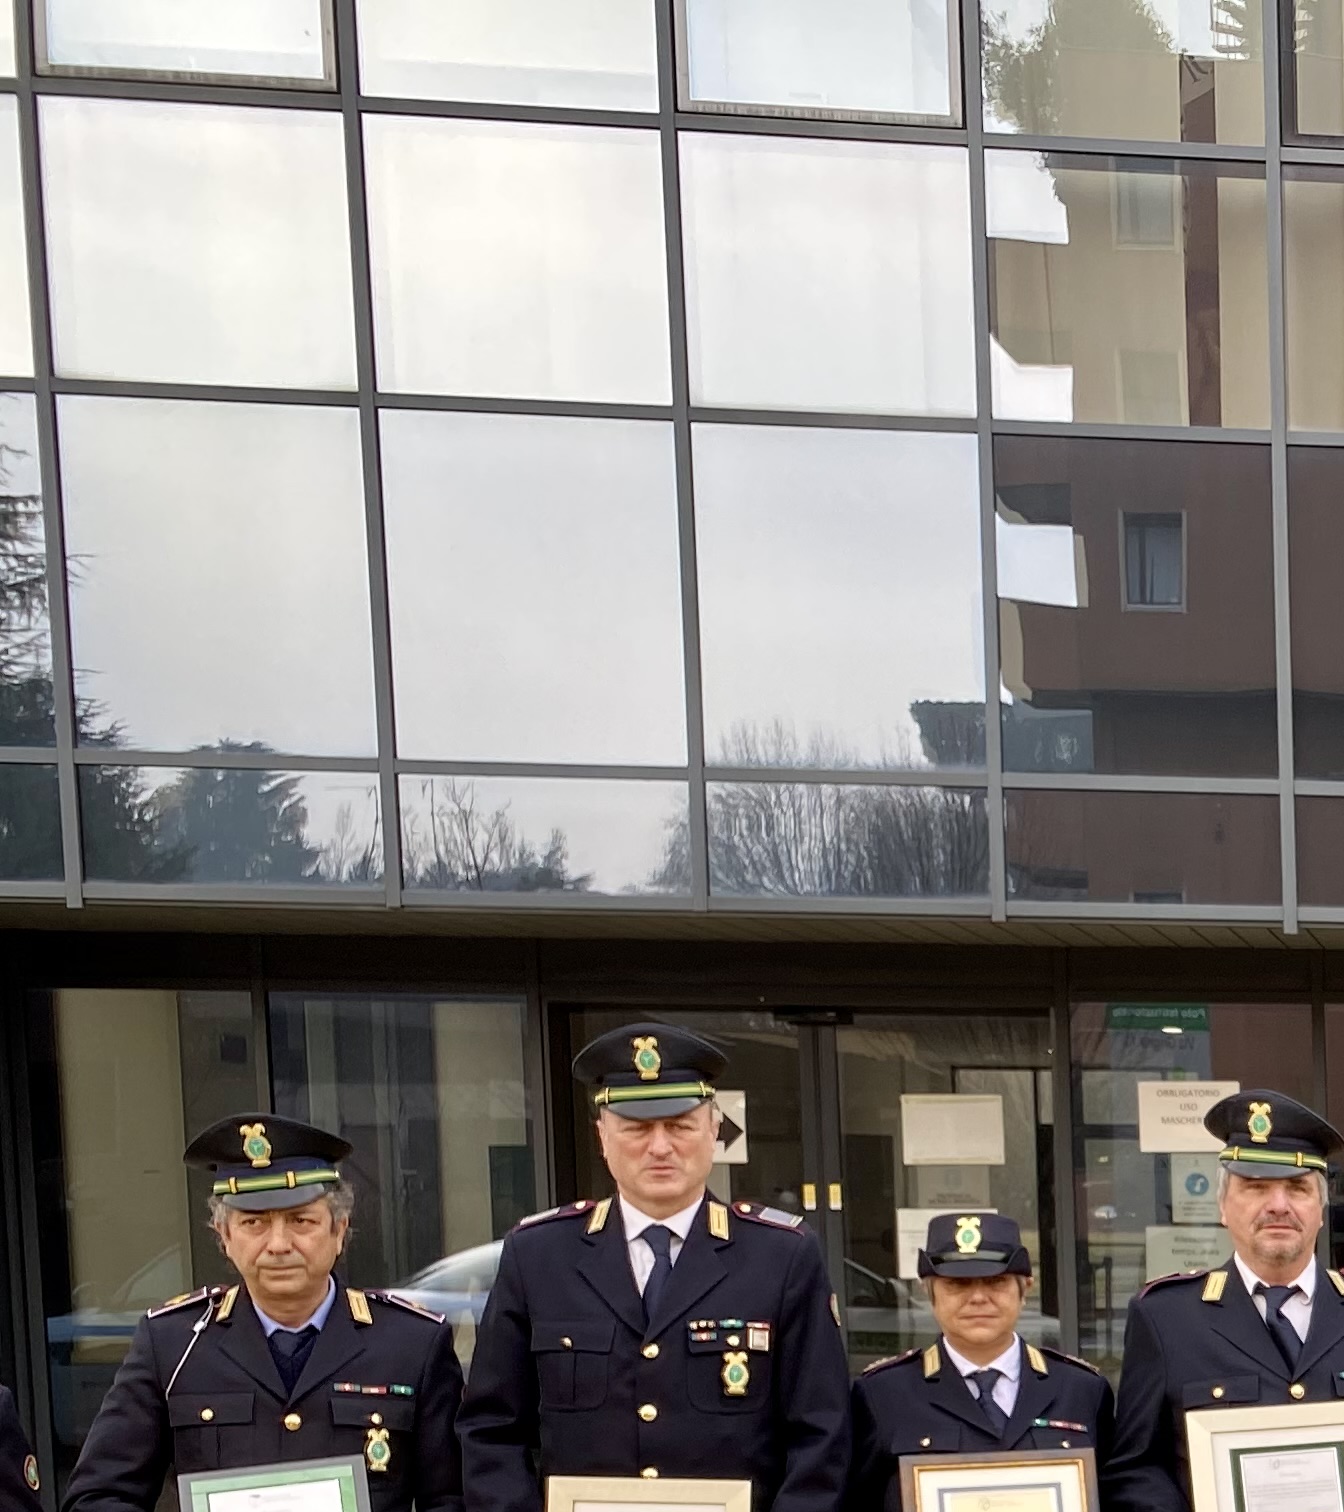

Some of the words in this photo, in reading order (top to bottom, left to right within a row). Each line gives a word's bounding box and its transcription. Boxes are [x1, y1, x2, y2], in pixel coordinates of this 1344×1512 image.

[1156, 1089, 1220, 1098] OBBLIGATORIO
[1180, 1103, 1198, 1112] USO
[1161, 1116, 1203, 1125] MASCHER
